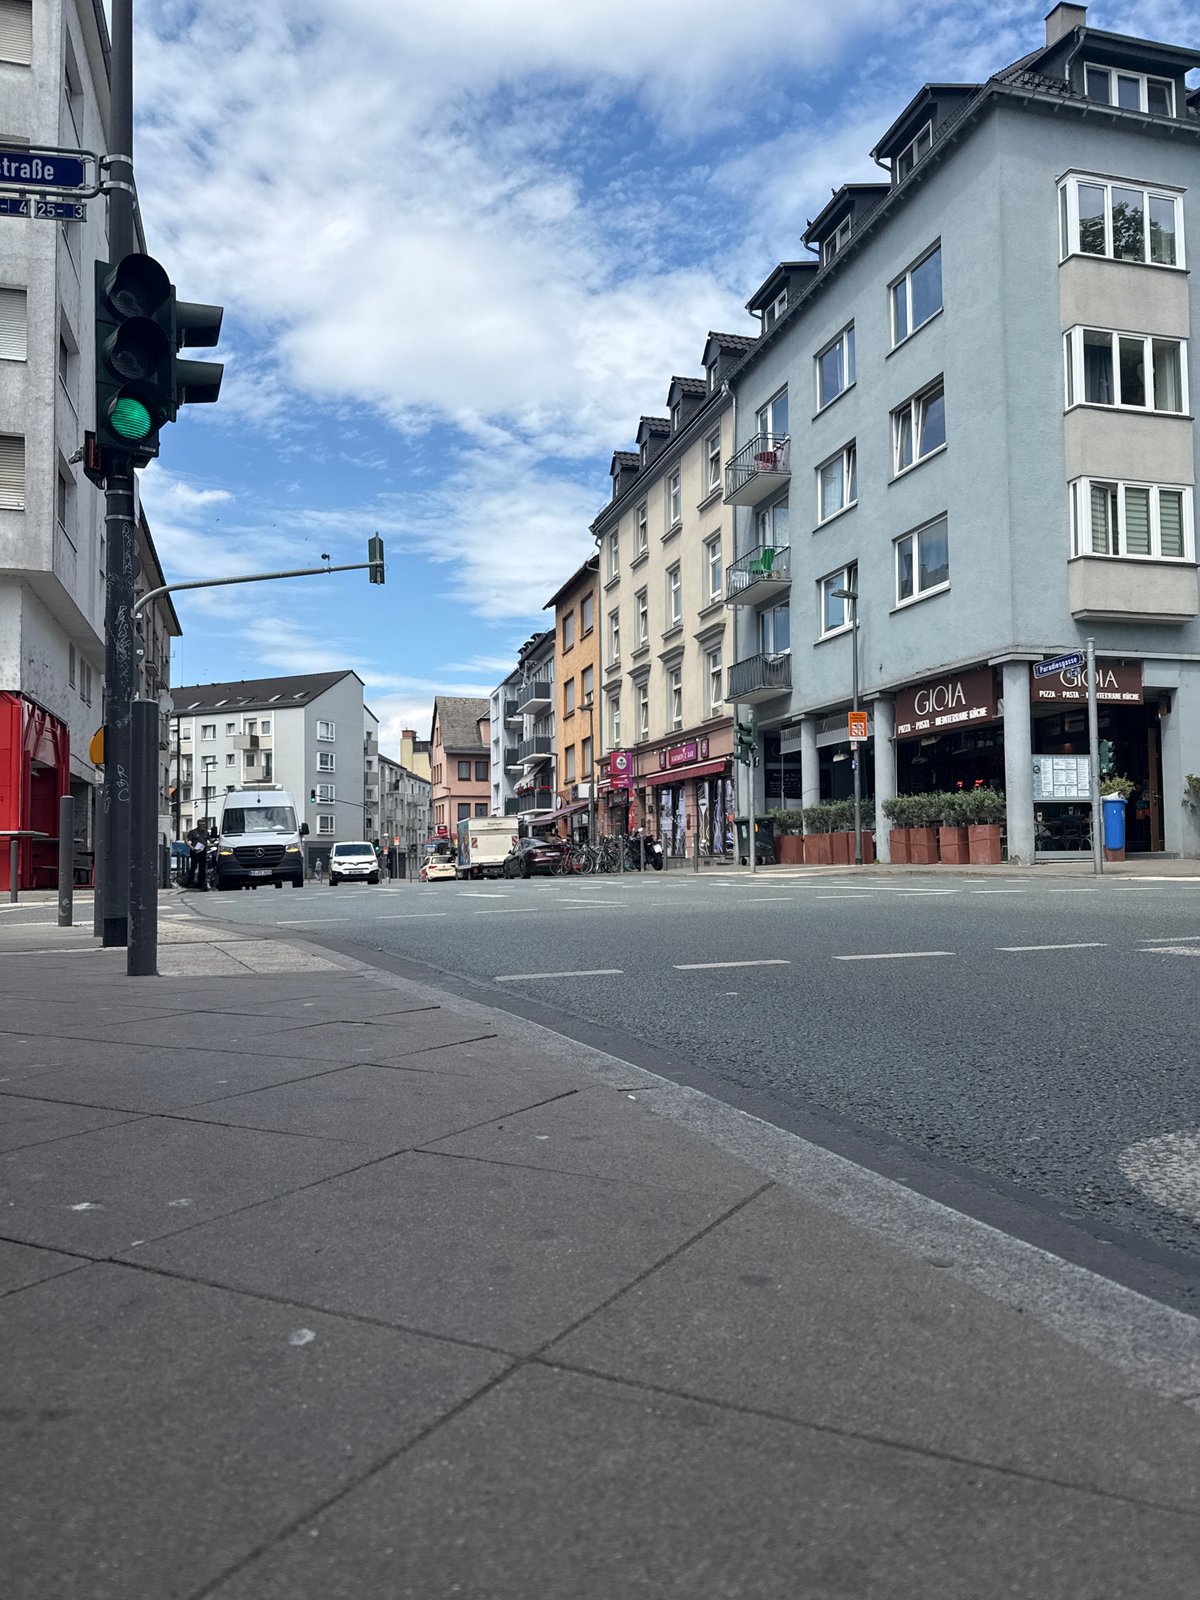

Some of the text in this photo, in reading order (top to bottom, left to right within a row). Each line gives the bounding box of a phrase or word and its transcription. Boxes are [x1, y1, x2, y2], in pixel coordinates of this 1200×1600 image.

[0, 157, 54, 180] traße
[1039, 657, 1078, 674] Paradiesgasse
[1060, 669, 1119, 688] GIOIA
[914, 681, 967, 715] GIOIA
[1039, 690, 1056, 698] PIZZA
[1062, 691, 1080, 699] PASTA
[898, 723, 911, 734] PIZZA
[915, 719, 930, 730] PASTA
